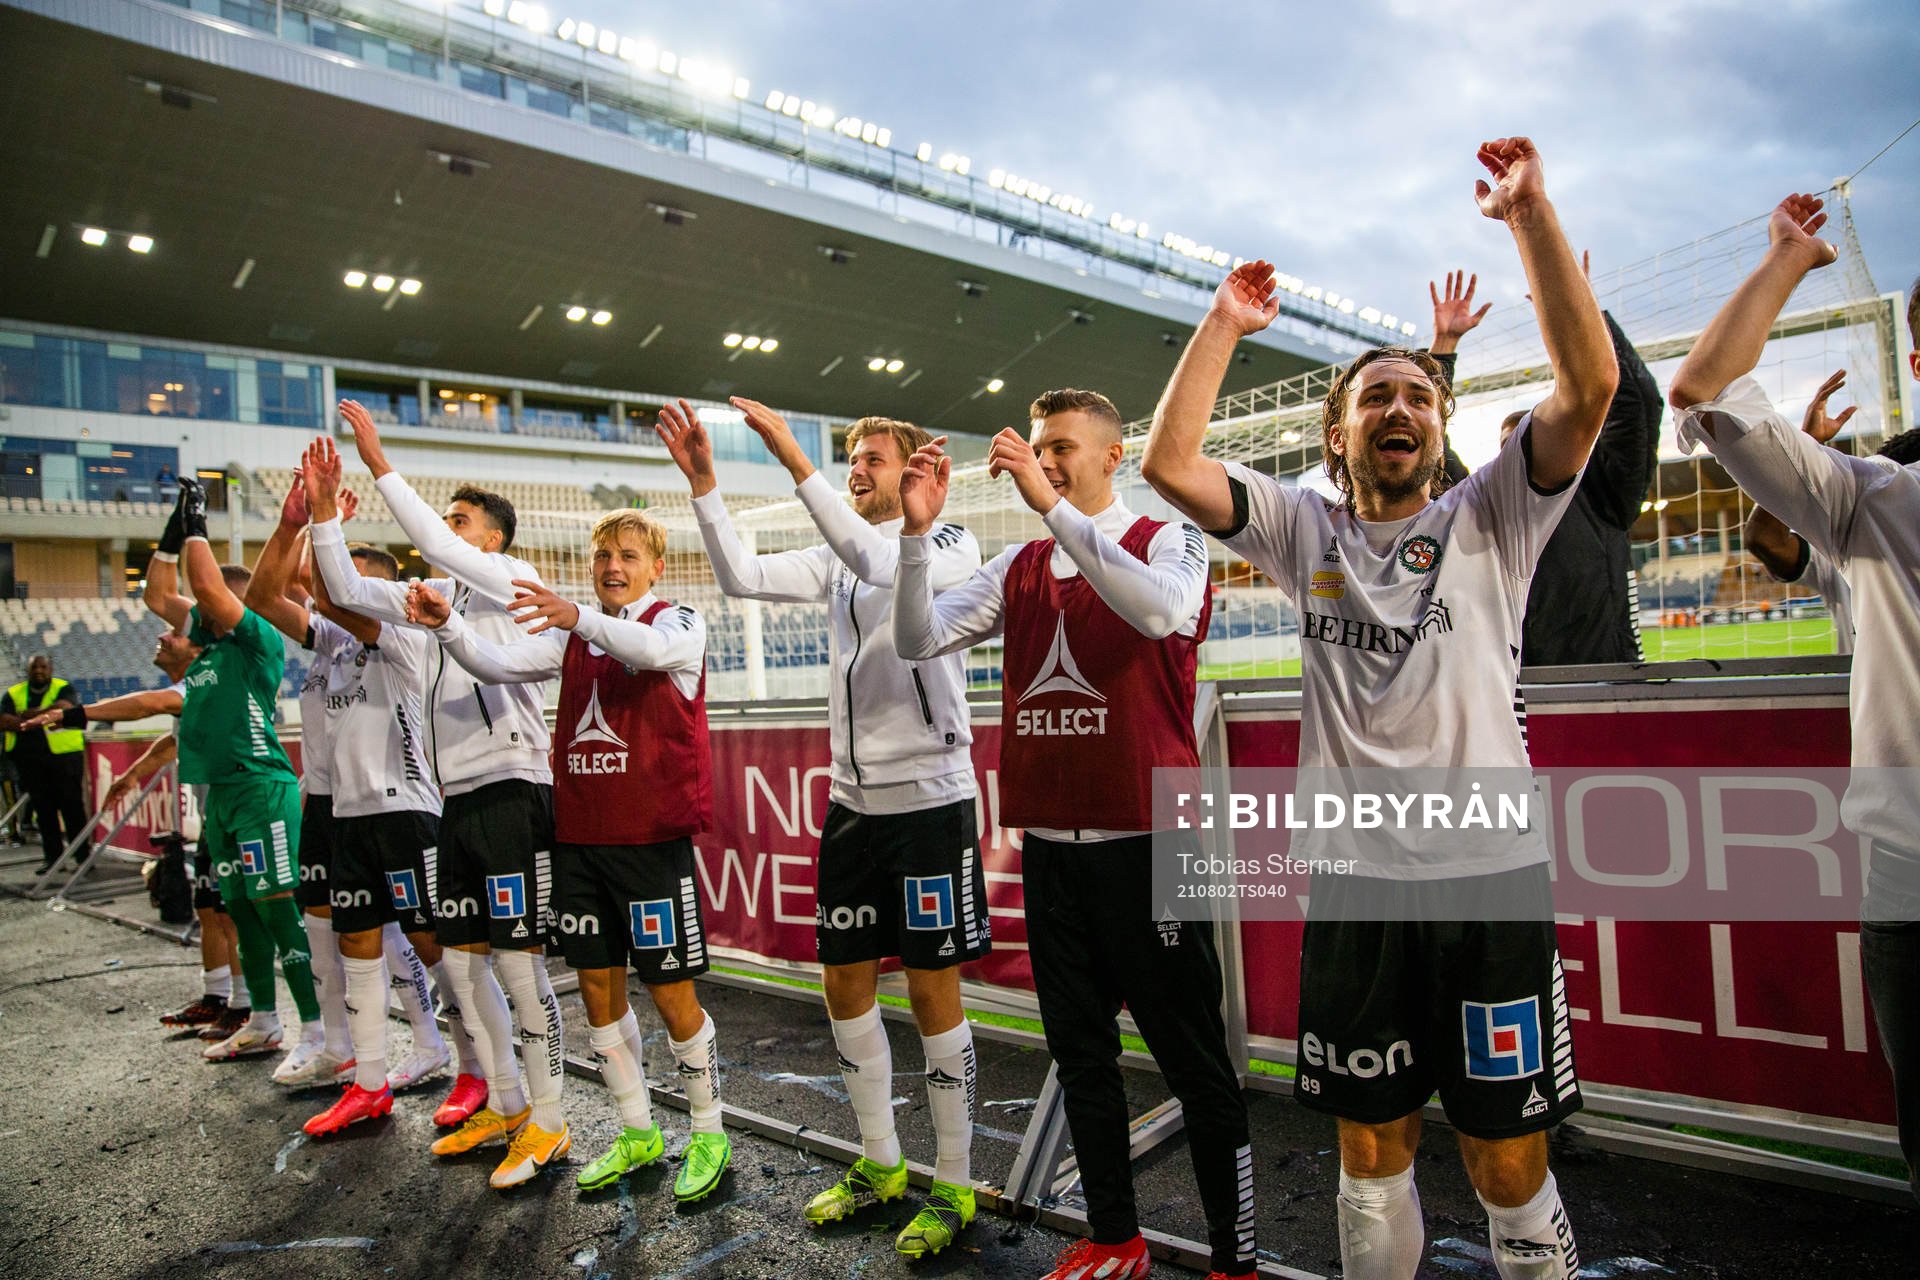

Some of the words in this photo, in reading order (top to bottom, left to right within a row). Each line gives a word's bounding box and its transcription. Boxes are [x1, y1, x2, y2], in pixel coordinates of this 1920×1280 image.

[1301, 611, 1422, 654] BEHRN
[1016, 707, 1108, 735] SELECT
[567, 751, 628, 774] SELECT
[1160, 931, 1180, 947] 12
[1301, 1074, 1321, 1096] 89
[1521, 1101, 1549, 1118] SELECT
